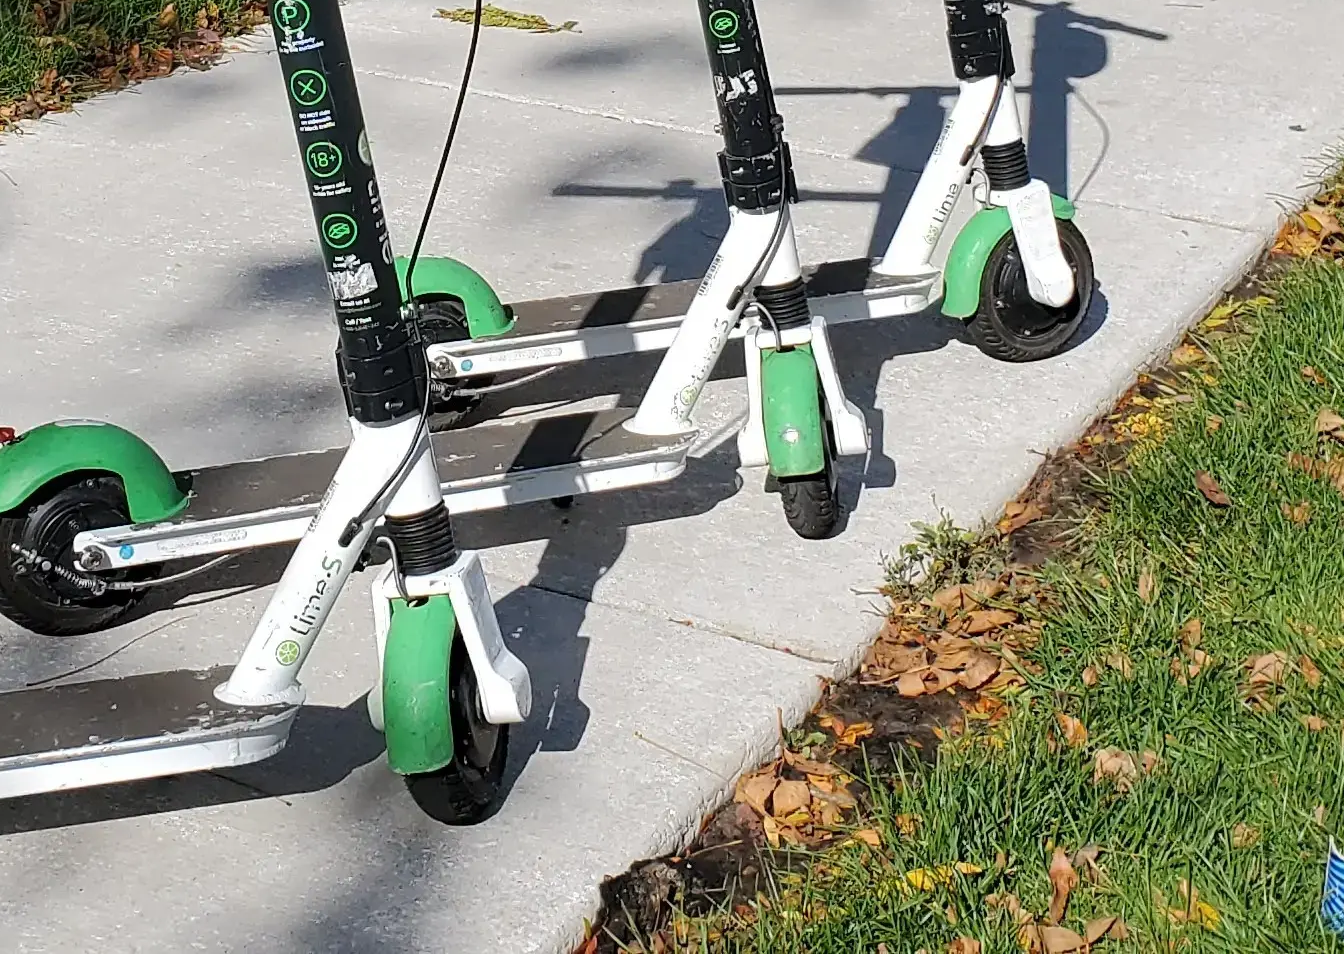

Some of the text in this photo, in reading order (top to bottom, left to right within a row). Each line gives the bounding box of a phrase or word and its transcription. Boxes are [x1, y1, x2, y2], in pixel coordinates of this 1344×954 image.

[281, 6, 298, 24] P
[311, 152, 336, 169] 18+
[932, 183, 959, 223] Lime
